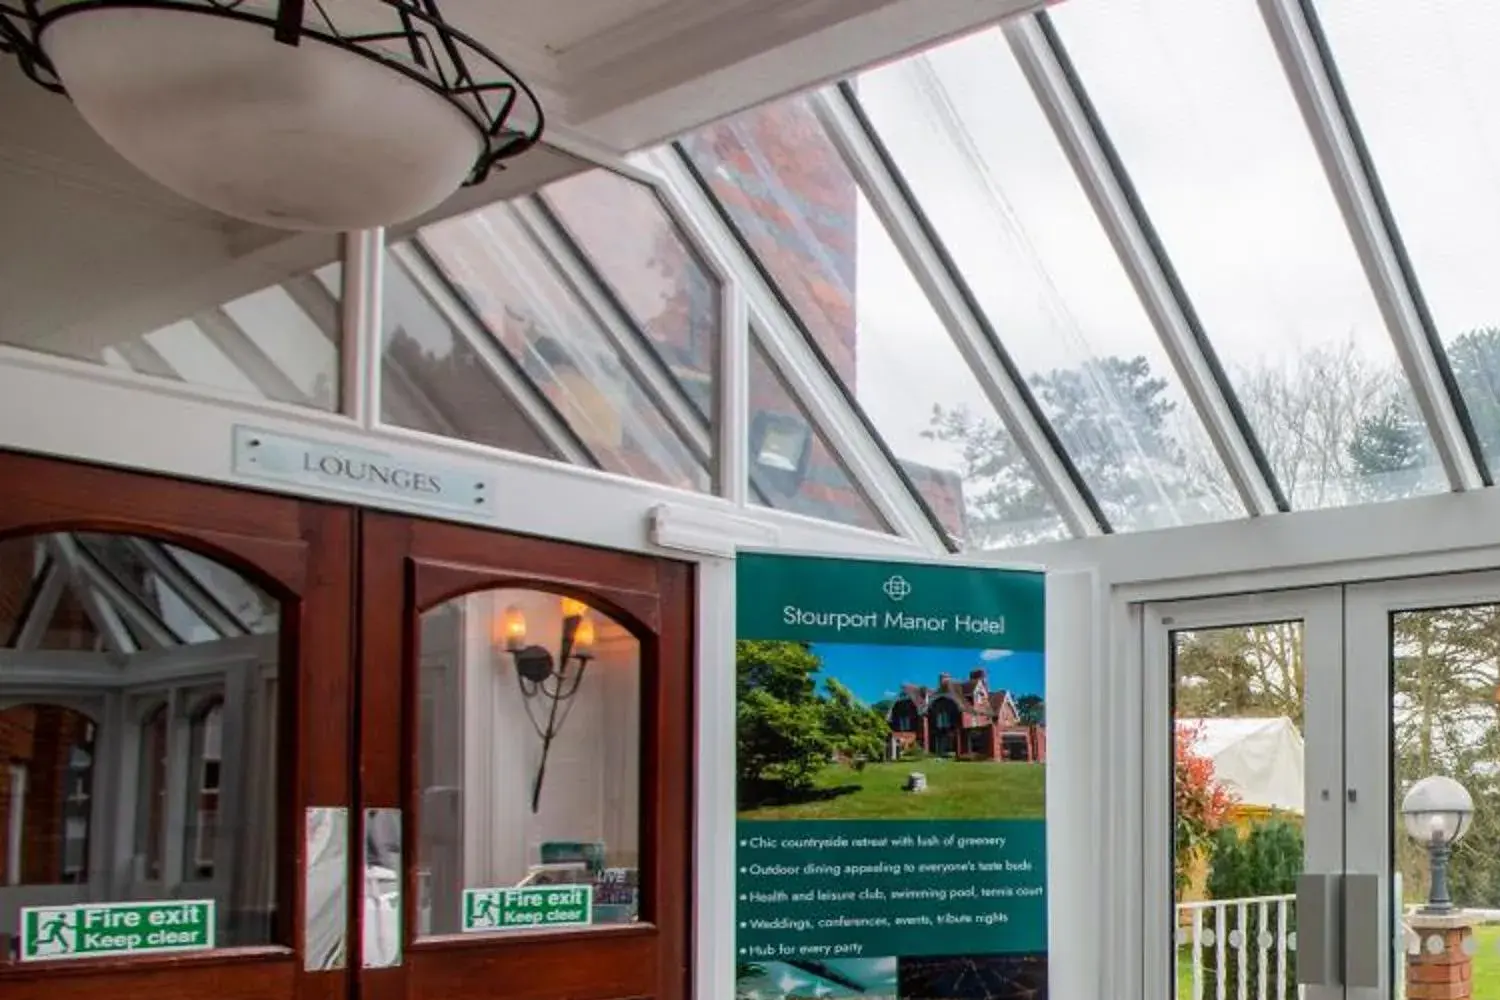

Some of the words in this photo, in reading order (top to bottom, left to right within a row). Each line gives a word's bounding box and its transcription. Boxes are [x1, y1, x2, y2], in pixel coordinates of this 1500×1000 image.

[303, 451, 442, 494] LOUNGES
[782, 605, 877, 632] Stourport
[884, 611, 948, 631] Manor
[954, 614, 1005, 634] Hotel
[749, 836, 777, 848] Chic
[781, 836, 849, 850] countryside
[851, 837, 889, 848] retreat
[890, 835, 914, 847] with
[917, 835, 939, 847] lush
[943, 834, 955, 846] of
[957, 836, 1006, 849] greenery
[749, 864, 800, 876] Outdoor
[803, 863, 841, 877] dining
[844, 861, 901, 876] appealing
[904, 862, 915, 873] to
[918, 860, 976, 876] everyone's
[978, 861, 1002, 872] taste
[1005, 859, 1032, 872] buds
[505, 891, 543, 908] Fire
[548, 889, 582, 905] exit
[749, 889, 789, 902] Health
[791, 889, 815, 901] and
[817, 889, 856, 902] leisure
[858, 887, 887, 901] club,
[890, 887, 947, 900] swimming
[949, 885, 978, 901] pool,
[981, 886, 1013, 898] tennis
[1015, 885, 1044, 897] court
[84, 907, 140, 929] Fire
[148, 904, 201, 925] exit
[504, 911, 543, 926] Keep
[546, 909, 583, 921] clear
[749, 917, 814, 931] Weddings,
[817, 915, 891, 928] conferences,
[894, 914, 933, 927] events,
[936, 913, 973, 924] tribute
[975, 911, 1009, 925] nights
[84, 931, 141, 951] Keep
[147, 929, 200, 945] clear
[749, 943, 777, 955] Hub
[779, 943, 795, 955] for
[799, 944, 833, 957] every
[833, 942, 863, 957] party
